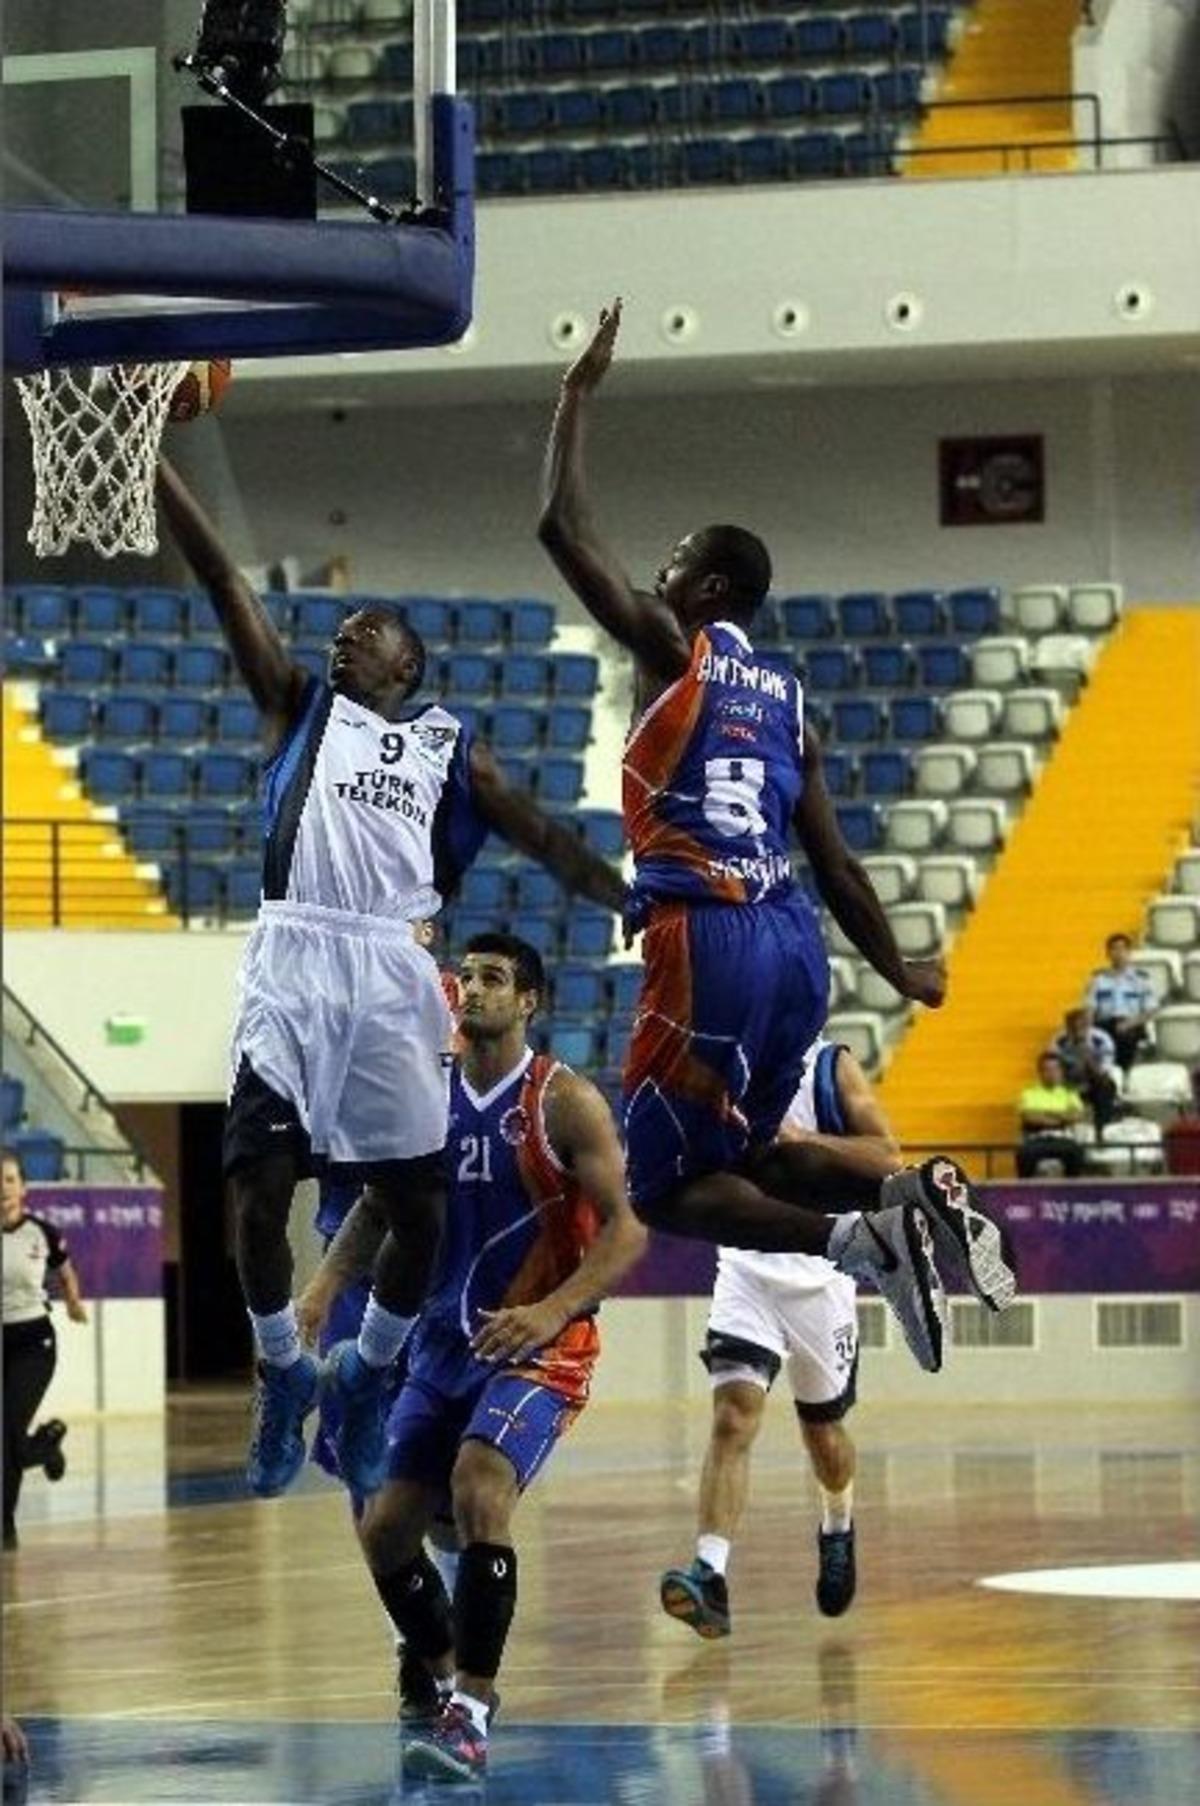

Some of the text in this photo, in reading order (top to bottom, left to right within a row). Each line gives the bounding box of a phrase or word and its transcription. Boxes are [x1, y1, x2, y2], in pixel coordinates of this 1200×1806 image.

[380, 733, 404, 764] 9
[355, 769, 415, 800] TÜRK
[702, 758, 767, 837] 8
[458, 1134, 493, 1182] 21
